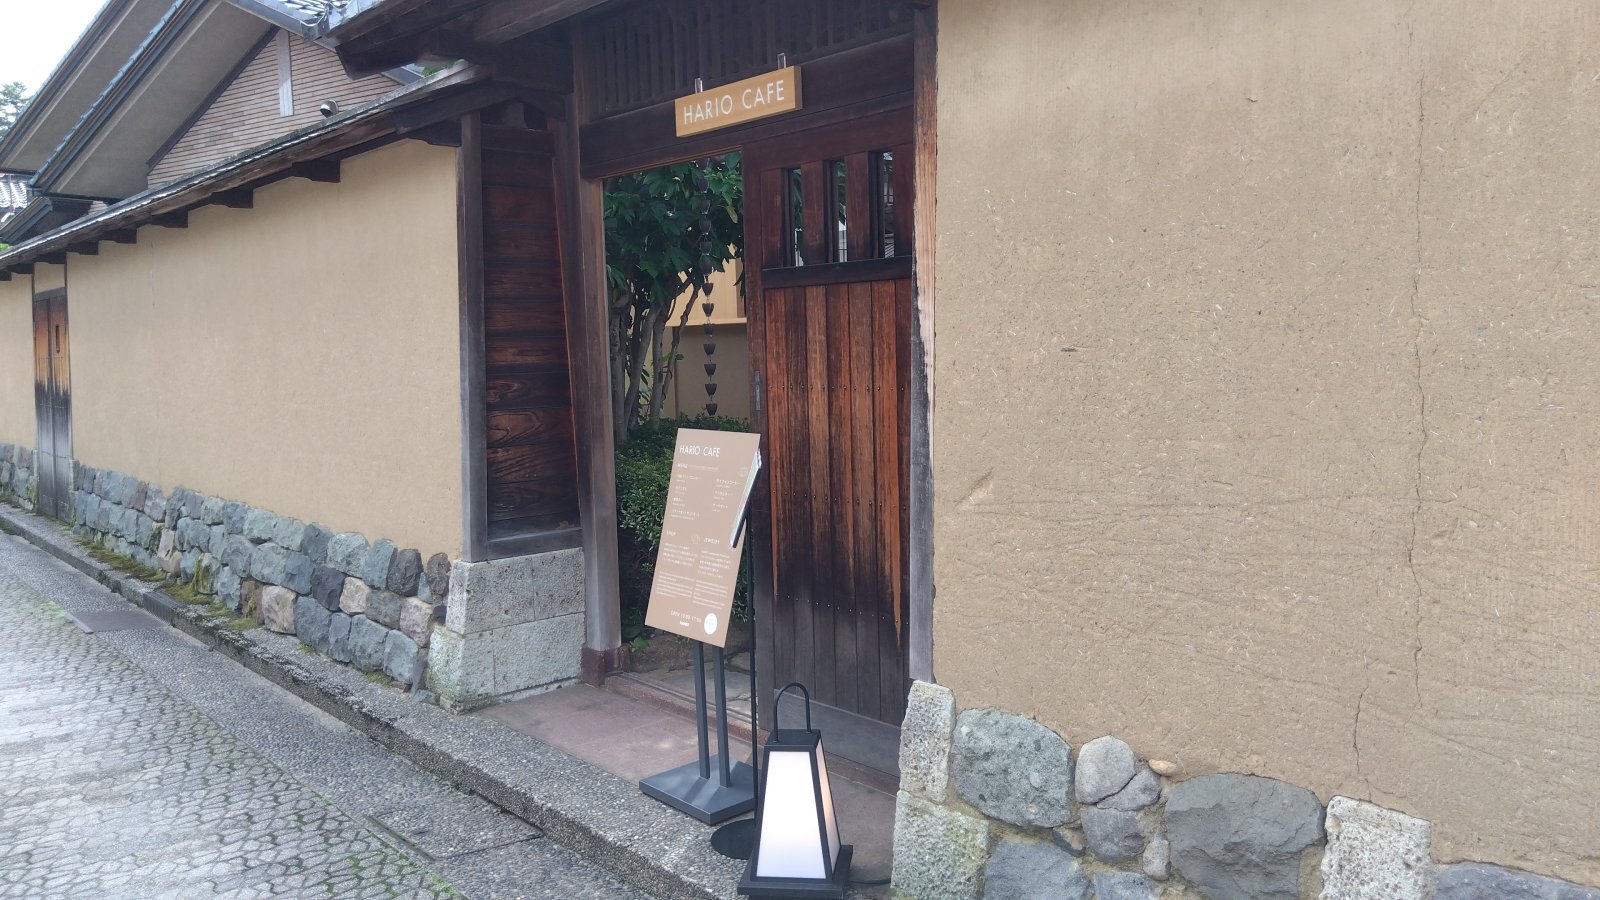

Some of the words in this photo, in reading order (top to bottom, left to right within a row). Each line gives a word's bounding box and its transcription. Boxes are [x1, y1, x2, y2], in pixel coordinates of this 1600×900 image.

[684, 95, 733, 125] HARIO
[742, 80, 785, 109] CAFE
[679, 444, 701, 456] HARIO
[703, 446, 720, 457] CAFE
